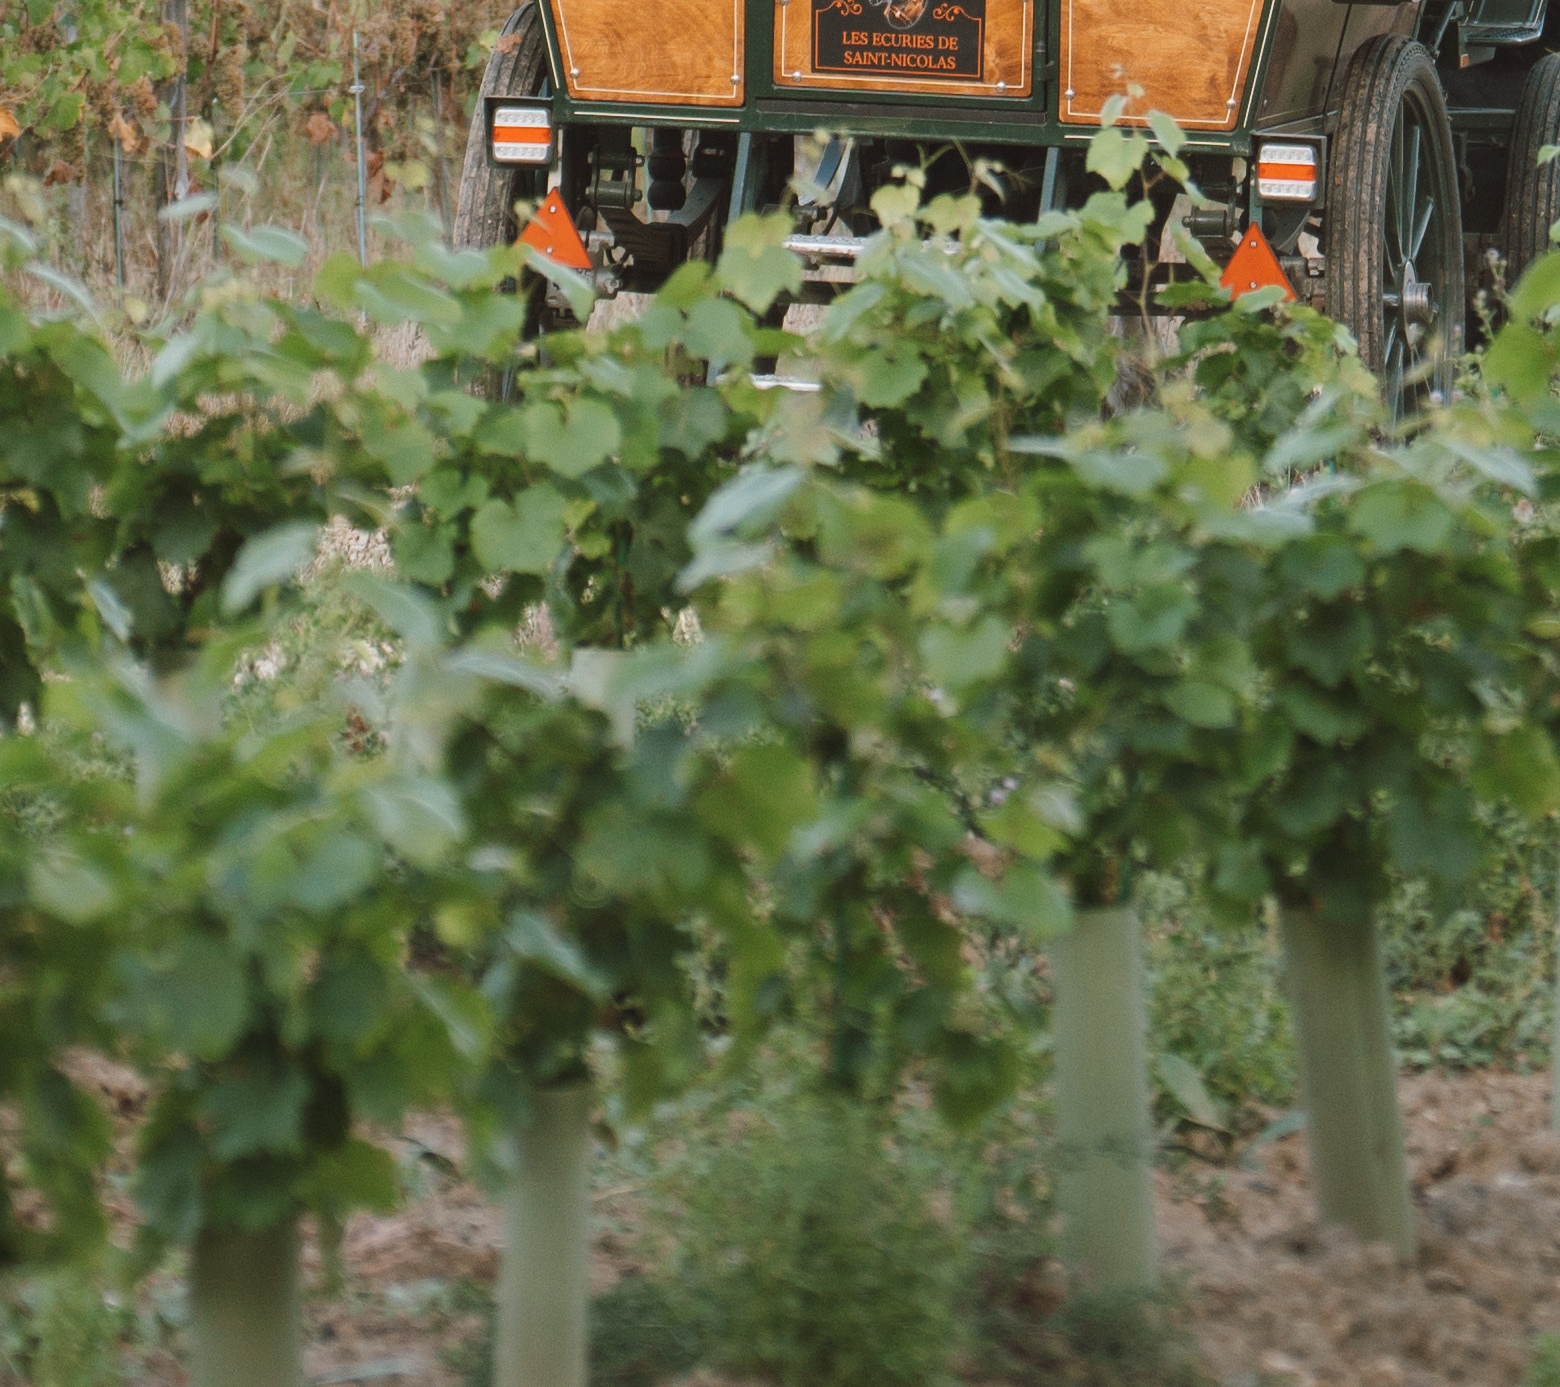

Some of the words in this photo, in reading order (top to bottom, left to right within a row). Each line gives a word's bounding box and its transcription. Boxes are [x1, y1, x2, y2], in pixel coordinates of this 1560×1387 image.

[842, 31, 868, 45] LES
[872, 33, 934, 49] ECURIES
[938, 36, 958, 50] DE
[843, 51, 956, 69] SAINT-NICOLAS
